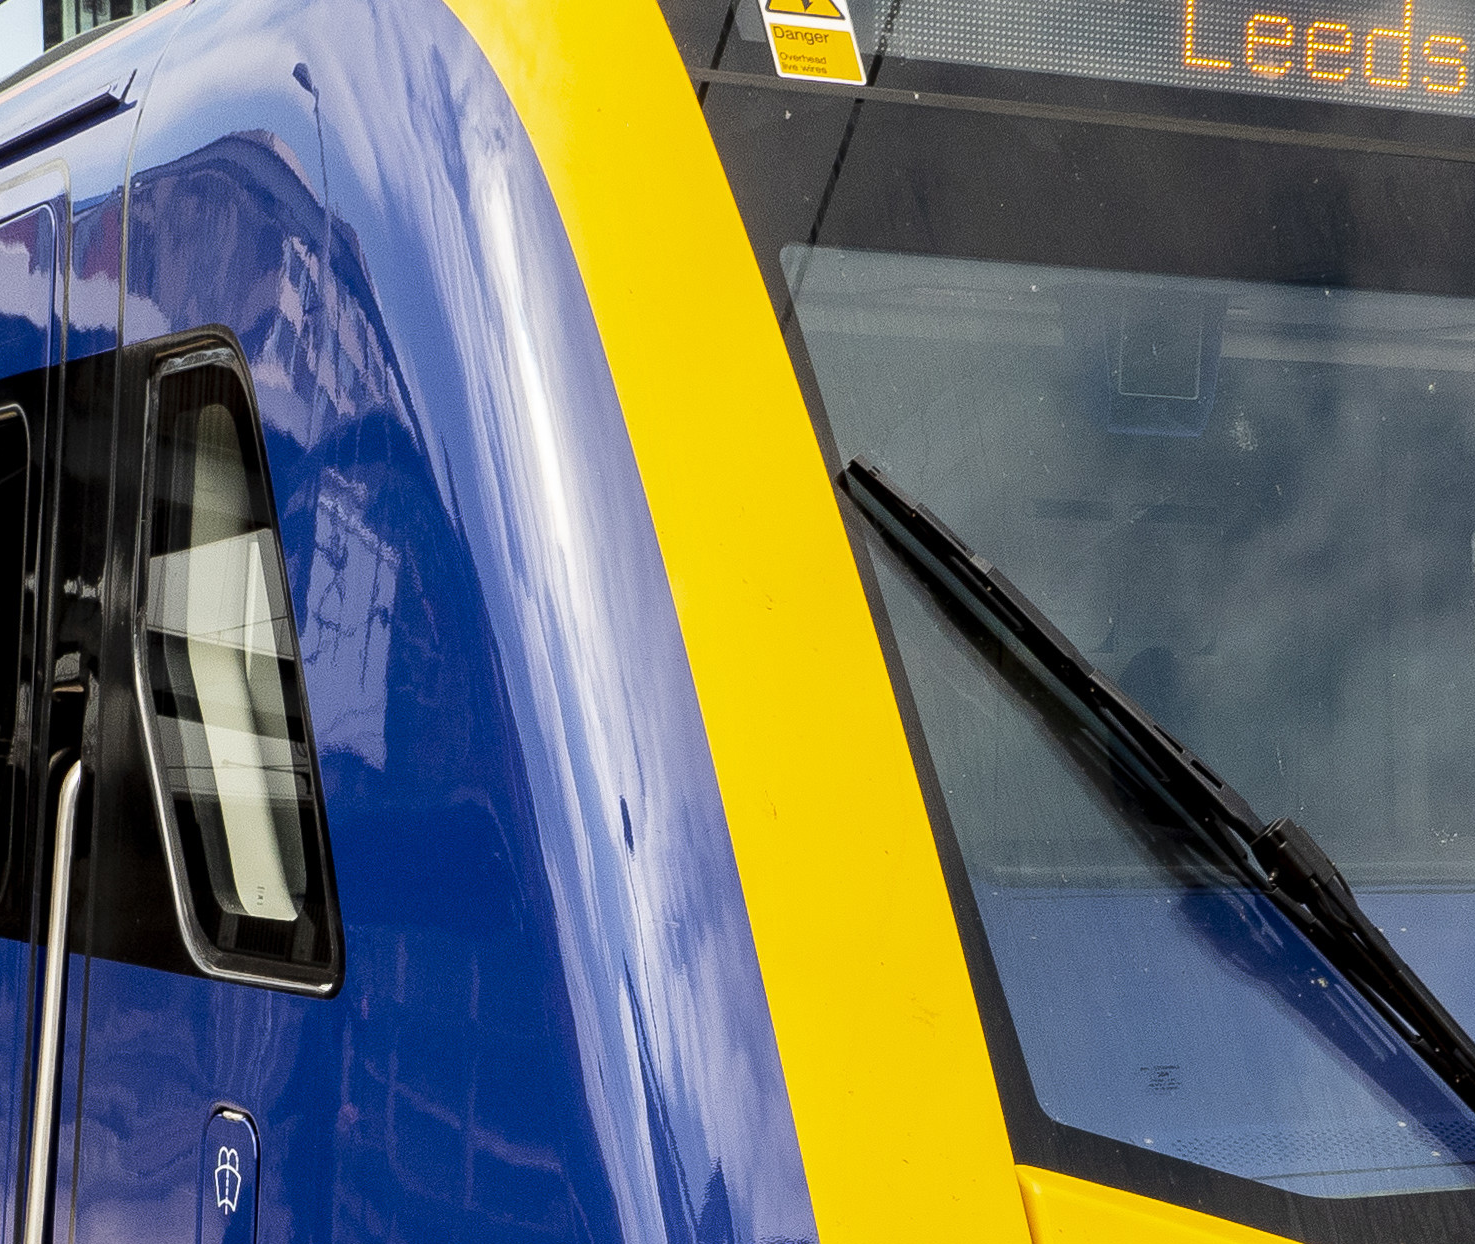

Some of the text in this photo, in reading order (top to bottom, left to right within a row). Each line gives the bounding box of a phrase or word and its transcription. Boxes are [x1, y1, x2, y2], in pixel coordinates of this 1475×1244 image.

[773, 26, 829, 45] Danger
[1184, 0, 1467, 93] Leeds
[779, 52, 827, 64] Overhead
[801, 64, 828, 74] wires
